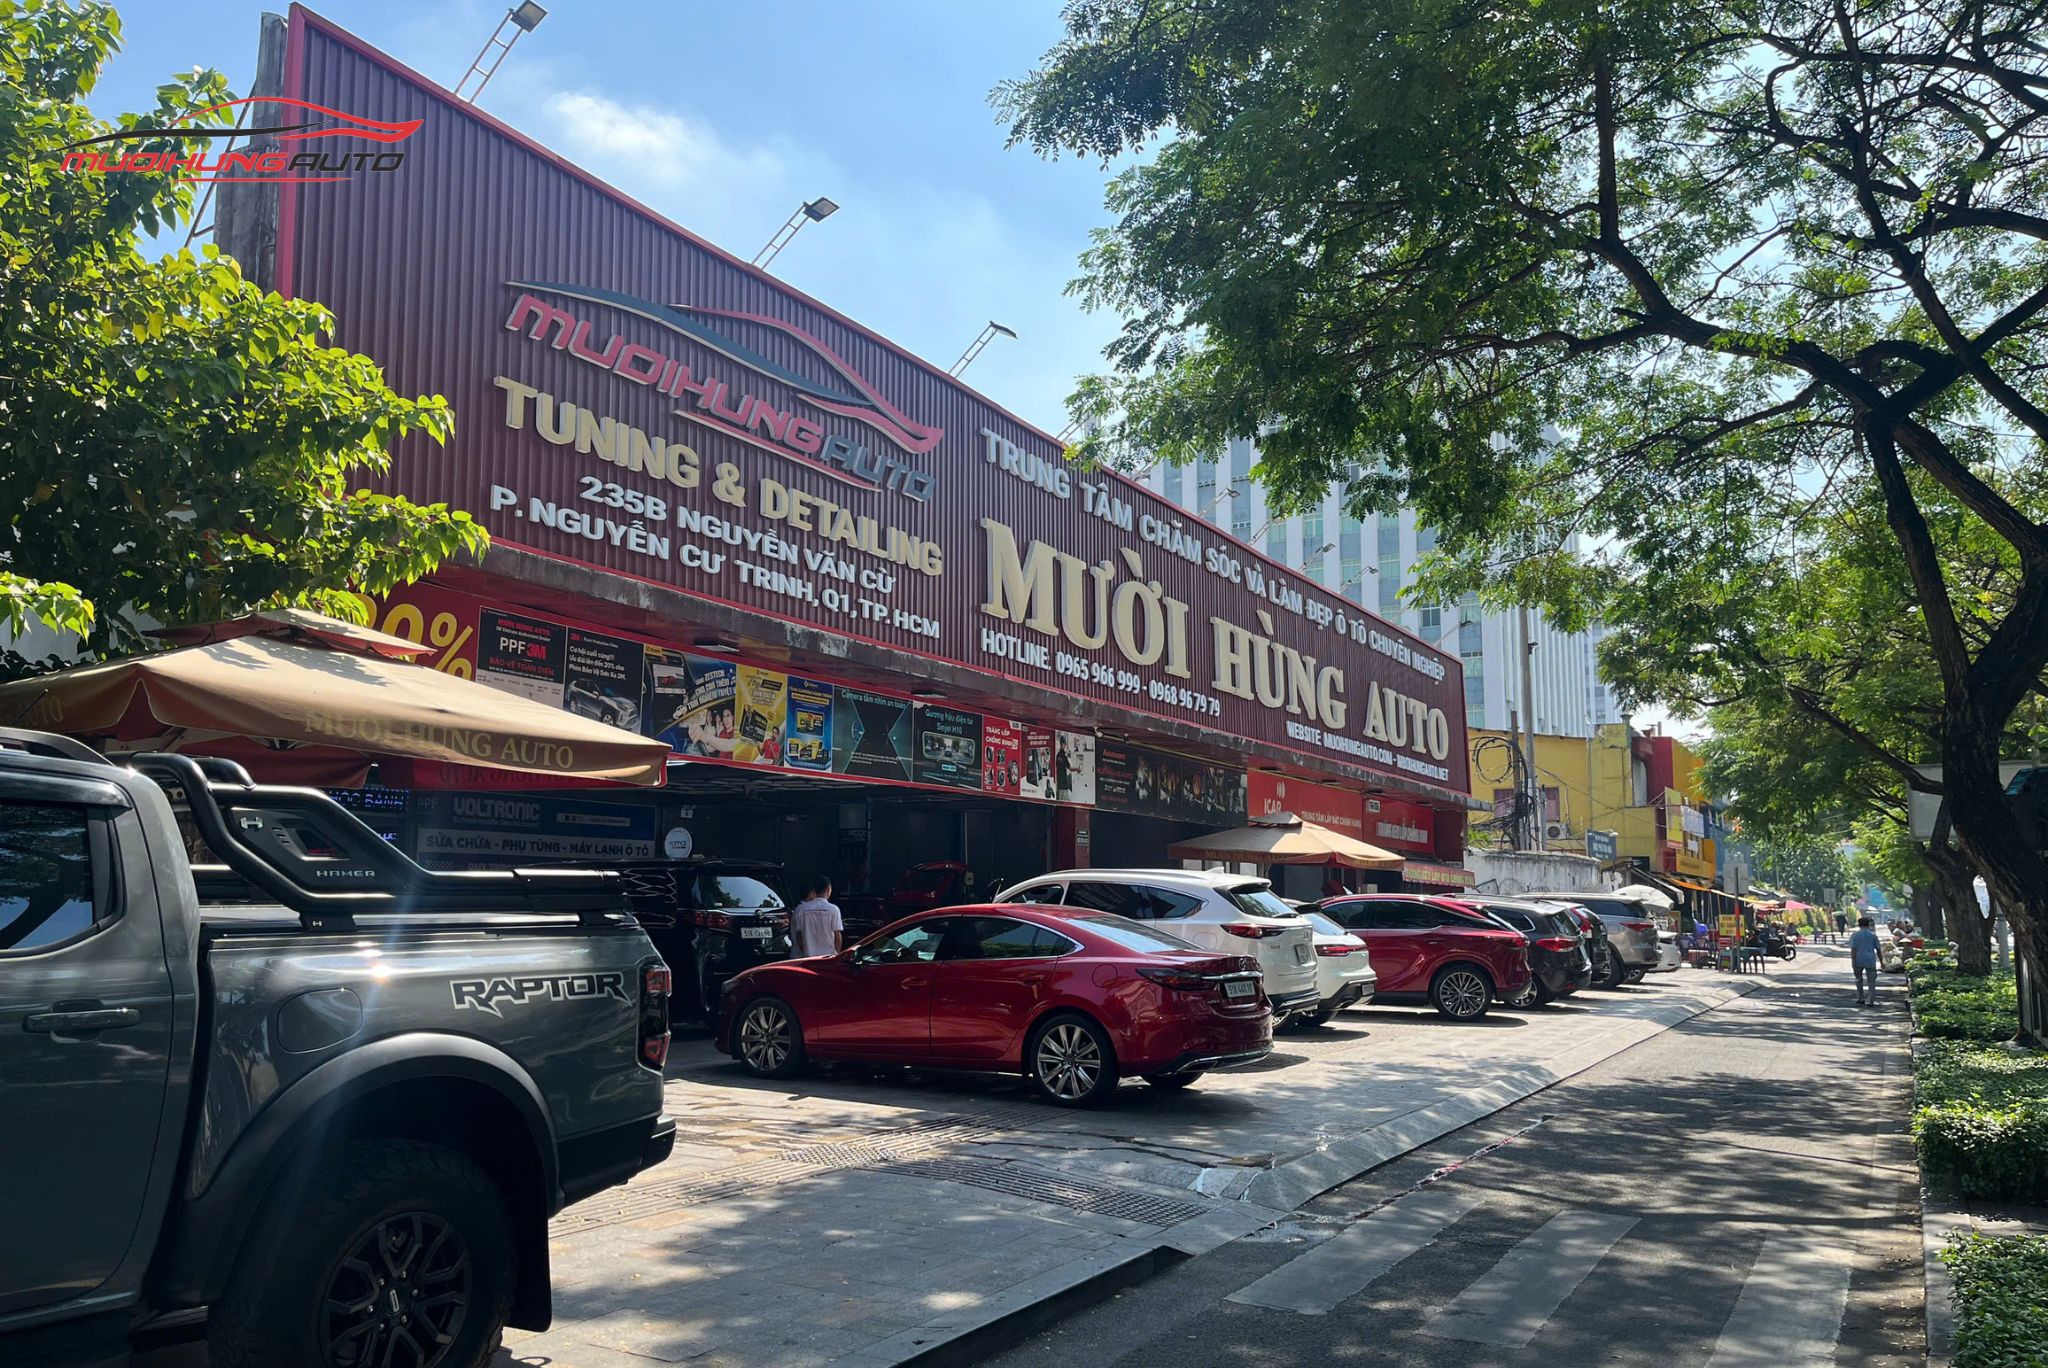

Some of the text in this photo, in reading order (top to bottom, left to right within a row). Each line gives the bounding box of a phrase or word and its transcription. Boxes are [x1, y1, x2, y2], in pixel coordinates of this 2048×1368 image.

[494, 376, 944, 577] TUNING & DETAILING
[579, 475, 896, 594] 235B NGUYỄN VĂN CỪ
[980, 427, 1445, 686] TRUNG TÂM CHĂM SÓC VÀ LÀM ĐẸP Ô TÔ CHUYÊN NGHIỆP
[679, 543, 726, 574] CƯ
[500, 637, 548, 660] PPF 3M
[980, 518, 1450, 761] MƯỜI HÙNG AUTO
[1055, 650, 1089, 681] 0965
[1090, 661, 1115, 688] 966
[1116, 670, 1140, 694] 999
[1149, 679, 1177, 705] 0968
[501, 738, 575, 769] AUTO
[1264, 798, 1282, 814] ICAR
[427, 831, 453, 849] SỬA
[456, 833, 492, 850] CHỮA
[502, 838, 527, 855] PHỤ
[529, 837, 561, 853] TÙNG
[570, 840, 593, 856] MÁY
[595, 843, 624, 859] LẠNH
[625, 842, 634, 856] Ô
[635, 842, 649, 857] TÔ
[449, 972, 632, 1018] RAPTOR
